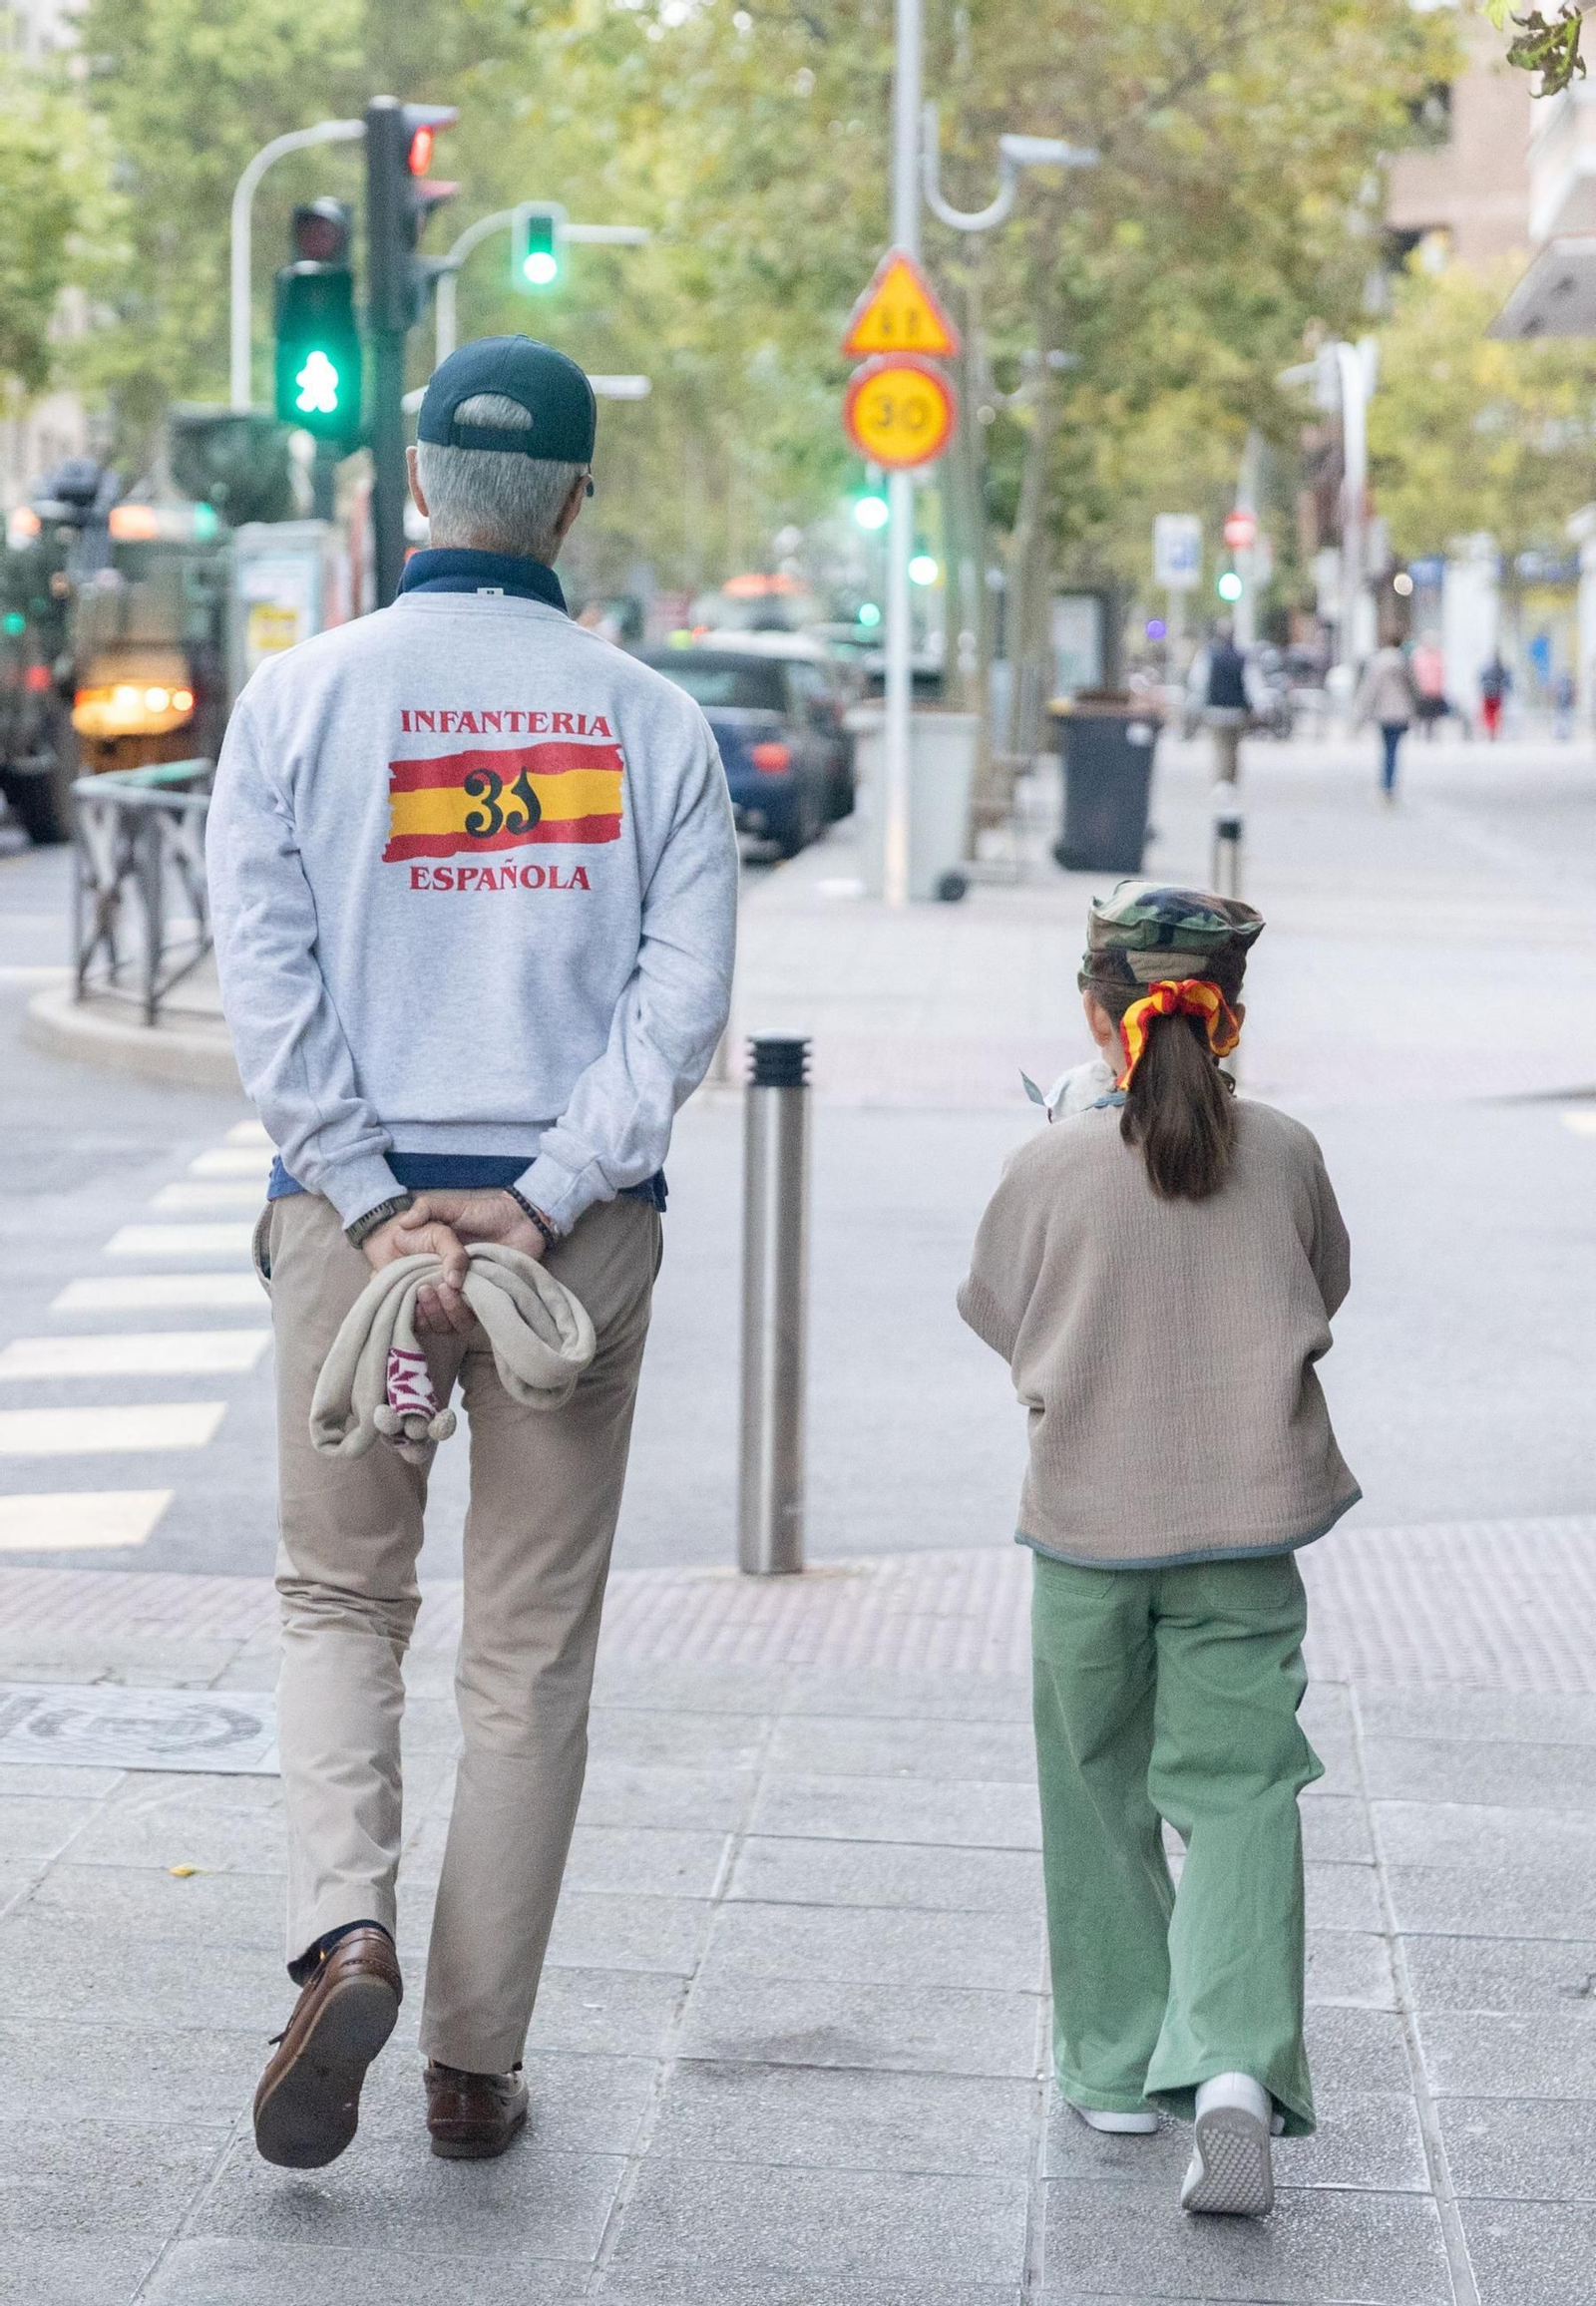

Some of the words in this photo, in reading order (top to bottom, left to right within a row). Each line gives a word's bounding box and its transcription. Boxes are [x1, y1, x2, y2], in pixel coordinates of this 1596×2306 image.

[871, 394, 932, 431] 30
[401, 709, 612, 737] INFANTERIA
[410, 858, 592, 891] ESPAÑOLA
